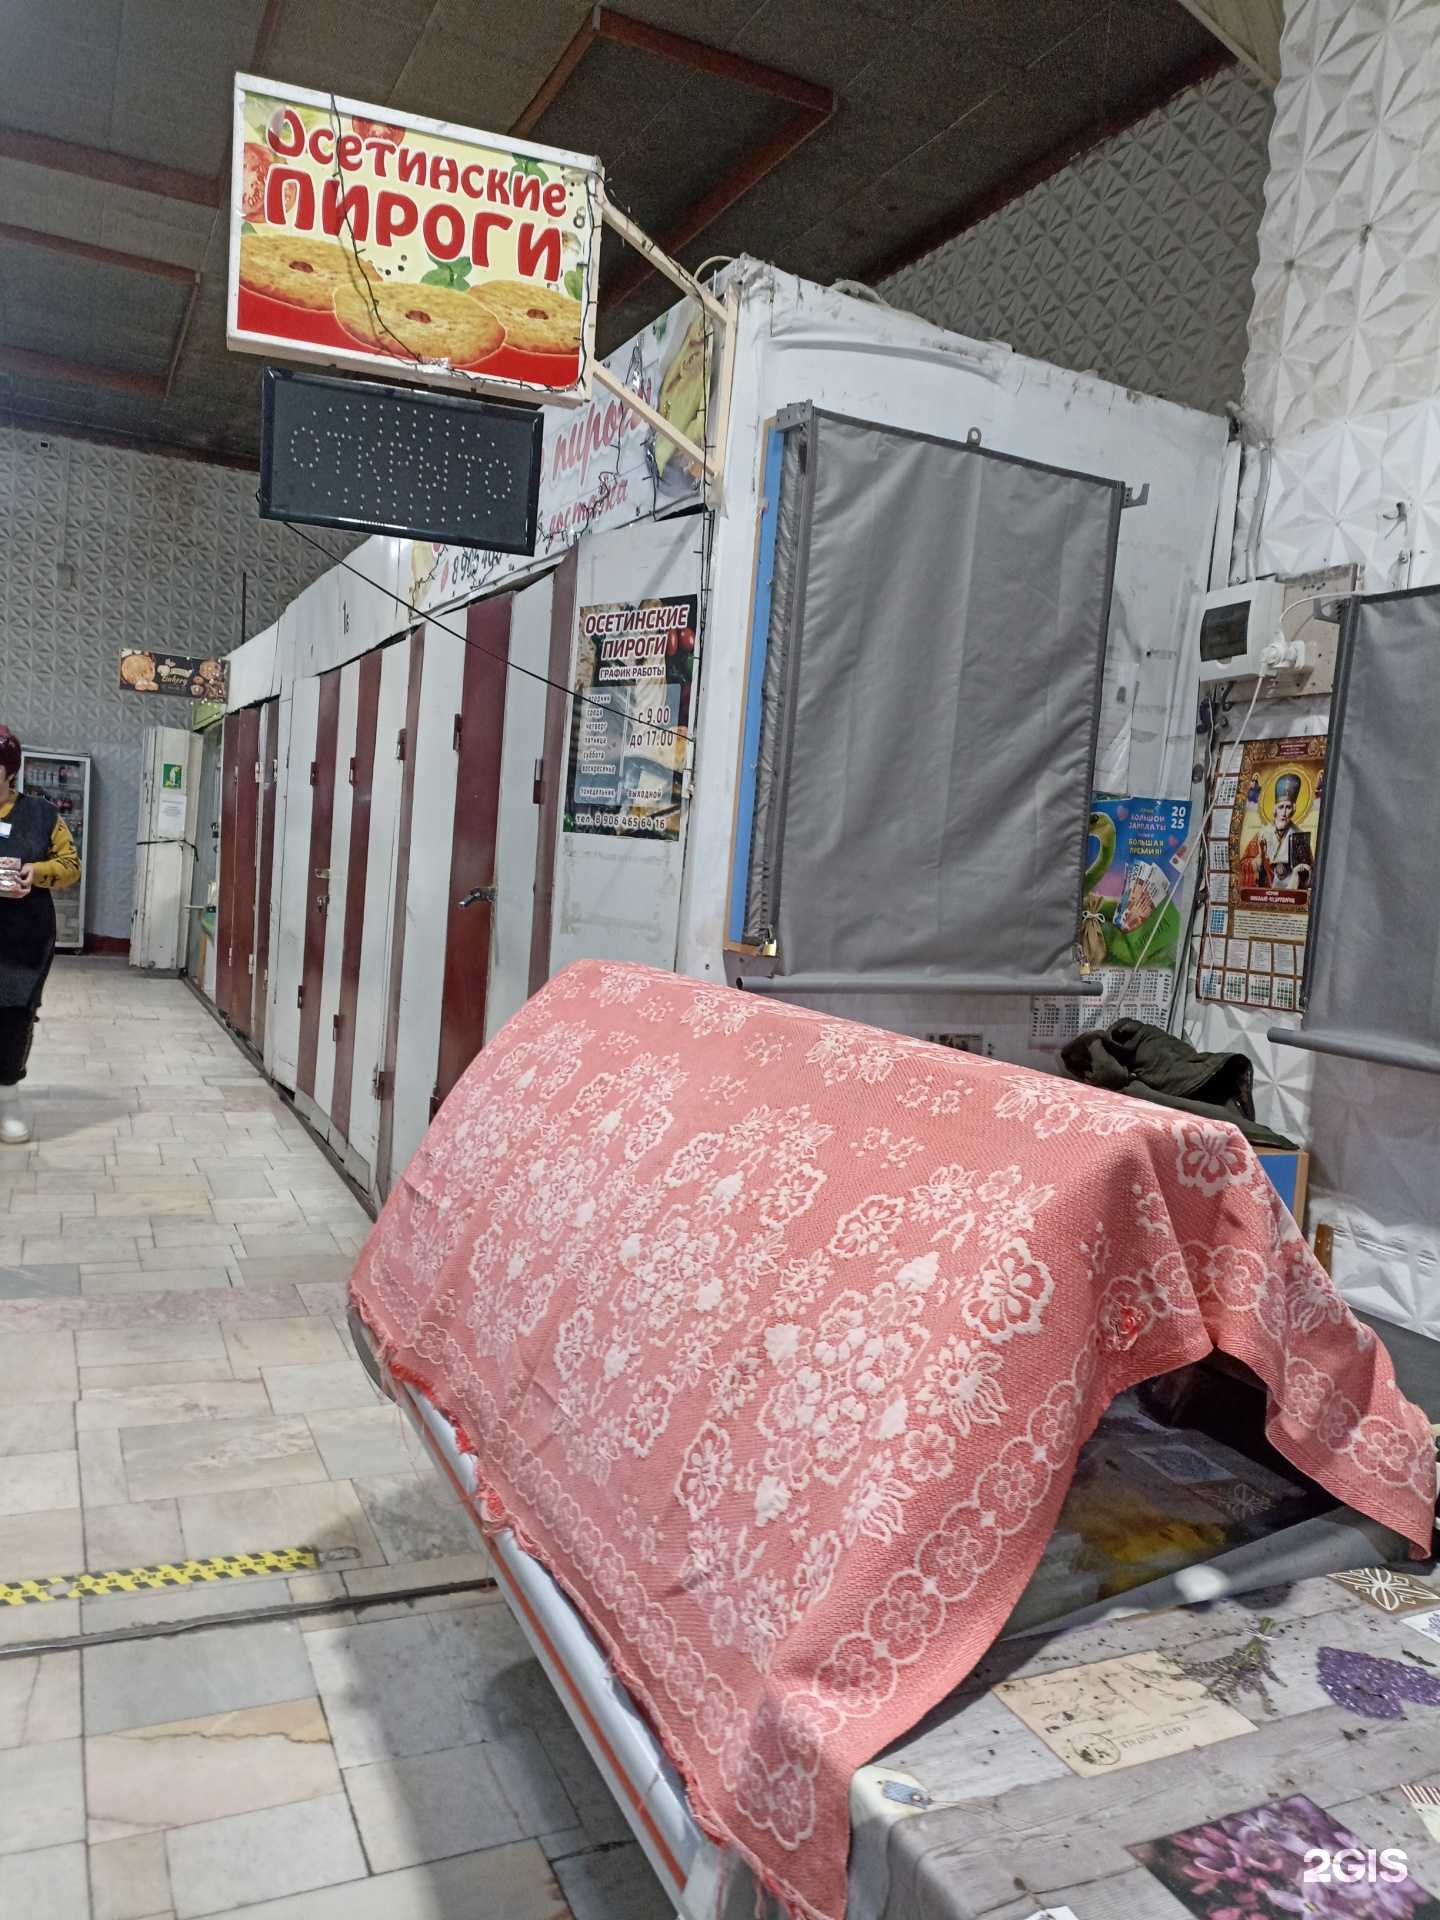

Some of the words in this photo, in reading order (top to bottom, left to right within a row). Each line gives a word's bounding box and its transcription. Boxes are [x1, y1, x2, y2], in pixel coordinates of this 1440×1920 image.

[266, 108, 567, 218] Осетинские
[290, 425, 513, 500] ОТКРЫТО
[585, 606, 690, 635] ОСЕТИНСКИЕ
[601, 636, 668, 660] ПИРОГИ
[600, 667, 631, 679] ГРАФИК
[632, 666, 665, 678] РАБОТЫ
[630, 735, 643, 749] до
[1171, 806, 1186, 817] 20
[603, 815, 619, 826] 906
[1170, 818, 1185, 829] 25
